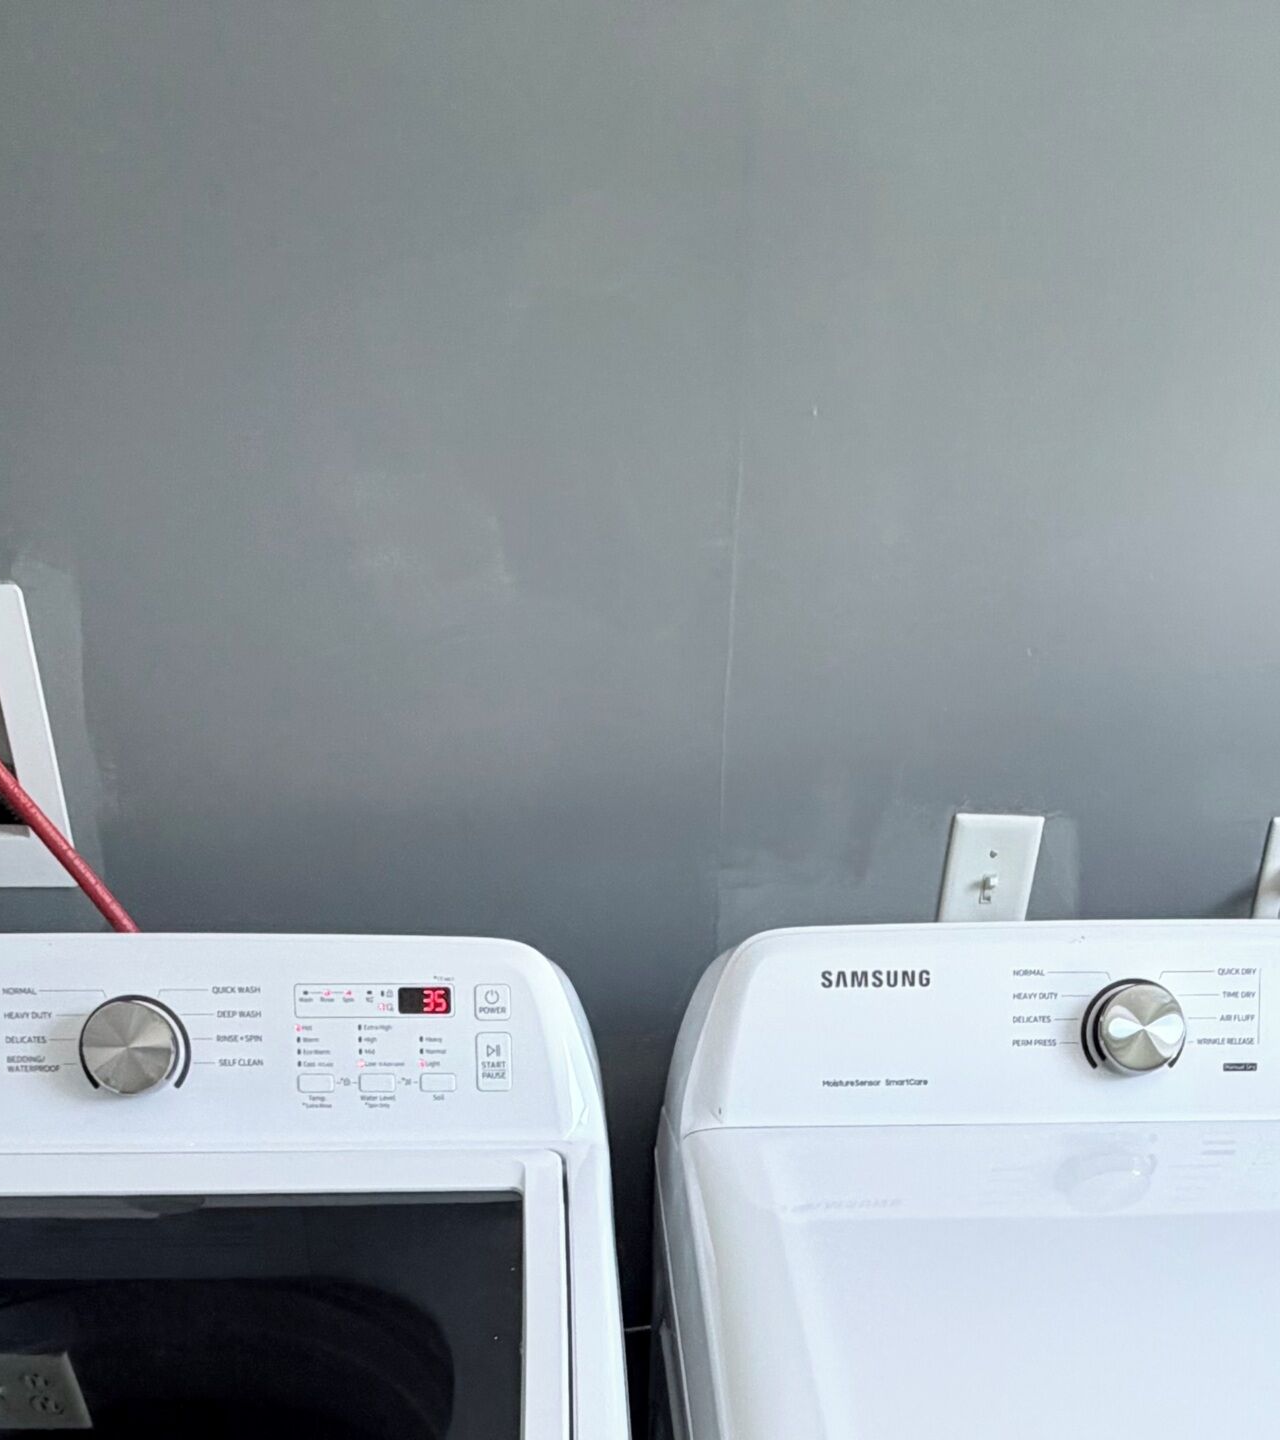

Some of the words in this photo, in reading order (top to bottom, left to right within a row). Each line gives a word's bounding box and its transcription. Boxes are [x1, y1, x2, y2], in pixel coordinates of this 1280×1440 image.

[1012, 969, 1046, 977] NORMAL
[1217, 967, 1241, 976] QUICK
[1241, 967, 1257, 976] DRY
[821, 969, 931, 988] SAMSUNG
[2, 986, 38, 996] NORMAL
[211, 986, 236, 995] QUICK
[237, 986, 261, 994] WASH
[1222, 990, 1240, 999] TIME
[1240, 991, 1257, 999] DRY
[1012, 992, 1038, 1000] HEAVY
[1038, 992, 1058, 1000] DUTY
[422, 989, 448, 1013] 35
[216, 1010, 237, 1018] DEEP
[238, 1010, 262, 1018] WASH
[478, 1005, 507, 1015] POWER
[3, 1010, 30, 1020] HEAVY
[31, 1010, 53, 1019] DUTY
[1012, 1015, 1052, 1024] DELICATES
[1219, 1014, 1233, 1022] AIR
[1233, 1013, 1256, 1022] FLUFF
[5, 1035, 48, 1045] DELICATES
[216, 1034, 239, 1042] RINSE
[245, 1034, 263, 1042] SPIN
[1196, 1037, 1226, 1046] WRINKLE
[1226, 1037, 1256, 1046] RELEASE
[1012, 1039, 1033, 1047] PERM
[1033, 1039, 1057, 1047] PRESS
[6, 1055, 47, 1064] BEDDING/
[218, 1058, 237, 1067] SELF
[237, 1058, 264, 1067] CLEAN
[6, 1064, 61, 1074] WATERPROOF
[481, 1060, 507, 1069] START
[481, 1071, 507, 1080] PAUSE
[884, 1078, 929, 1087] SmartCare
